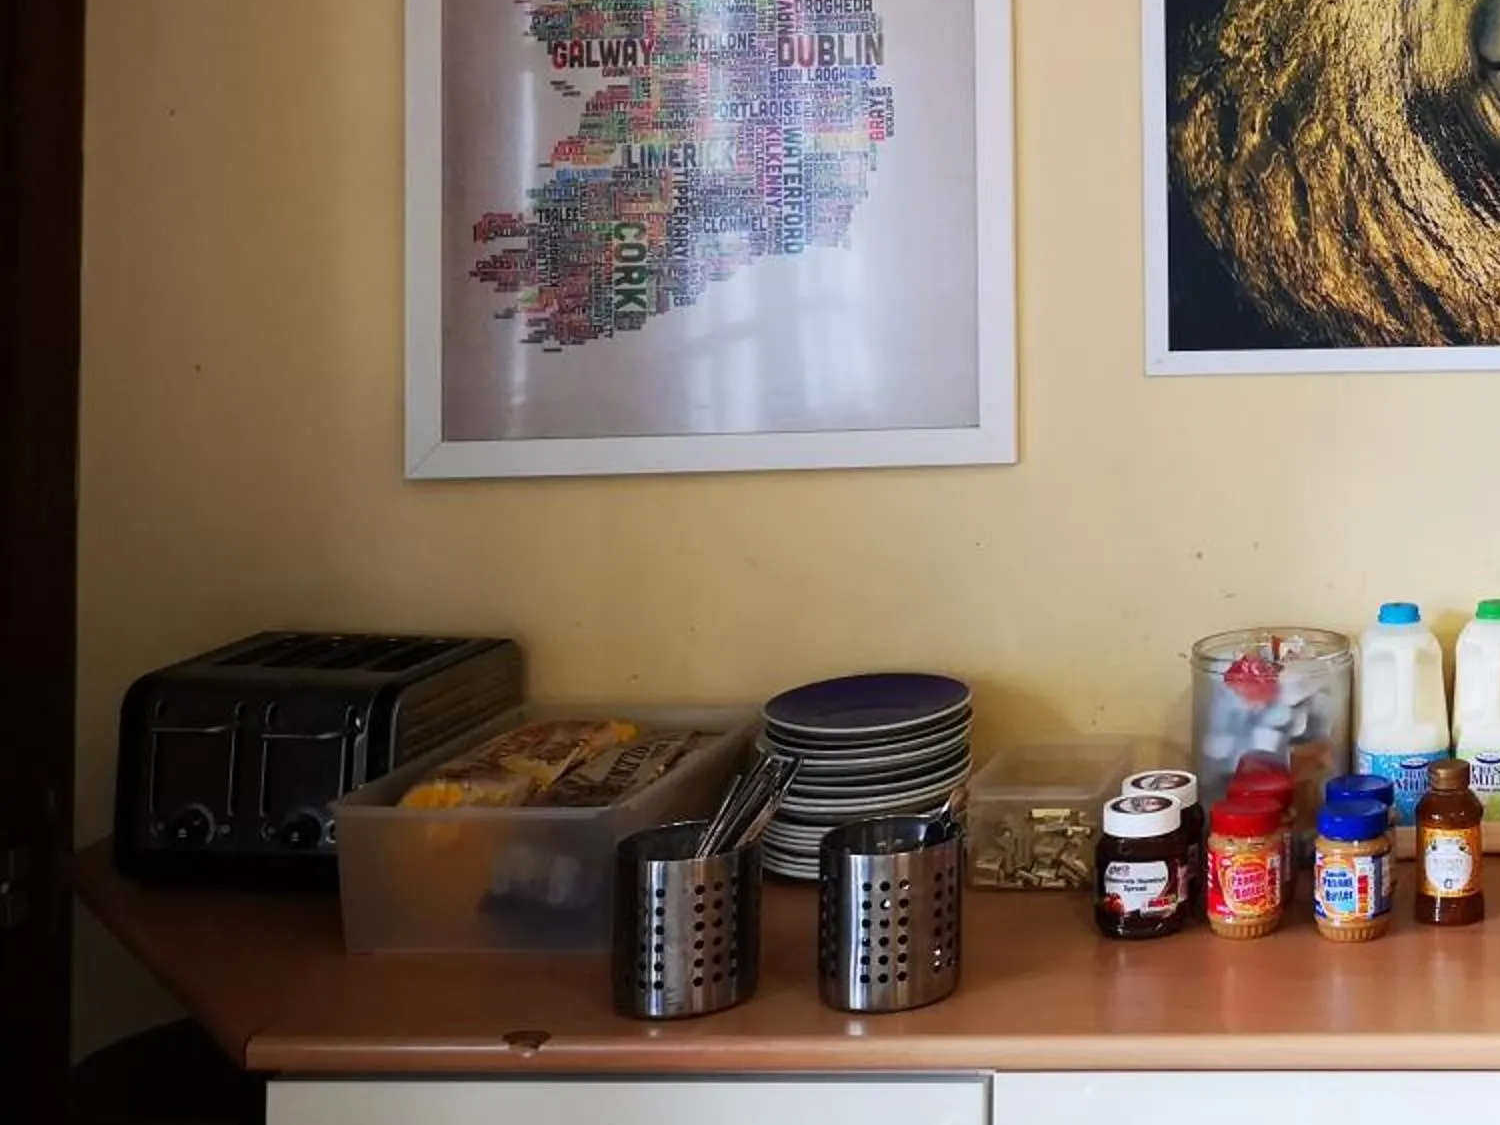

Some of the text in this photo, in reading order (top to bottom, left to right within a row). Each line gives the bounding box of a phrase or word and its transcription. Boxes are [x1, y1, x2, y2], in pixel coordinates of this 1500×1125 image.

[552, 38, 655, 69] GALWAY
[689, 32, 757, 52] ATHLONE
[777, 33, 885, 68] DUBLIN
[777, 68, 802, 82] DUN
[868, 98, 885, 142] BRAY
[625, 139, 736, 171] LIMERICK
[765, 126, 783, 208] KILKENNY
[783, 125, 804, 255] WATERFORD
[673, 169, 689, 259] TIPPERARY
[703, 216, 767, 234] CLONMEL
[613, 221, 647, 310] CORK
